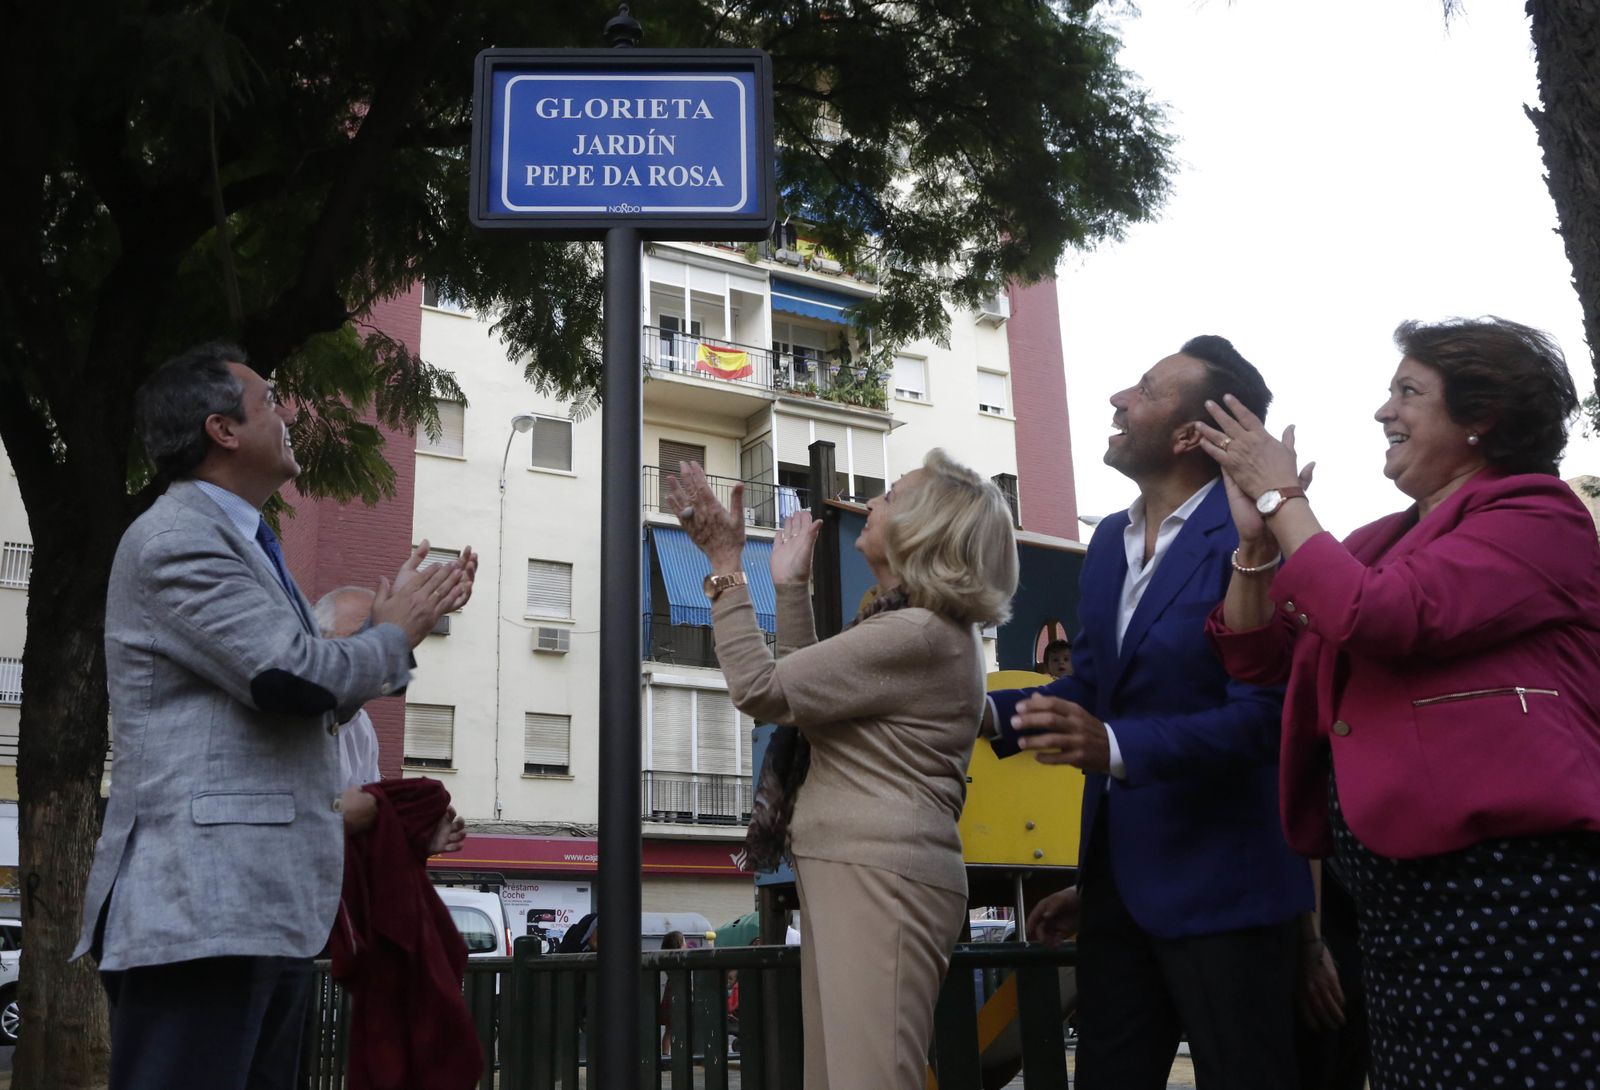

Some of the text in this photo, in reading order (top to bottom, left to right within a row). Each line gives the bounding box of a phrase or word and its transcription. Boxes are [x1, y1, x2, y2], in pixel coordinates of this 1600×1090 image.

[535, 97, 714, 119] GLORIETA
[572, 128, 677, 156] JARDÍN
[525, 165, 724, 187] PEPE DA ROSA
[502, 891, 525, 899] Coche
